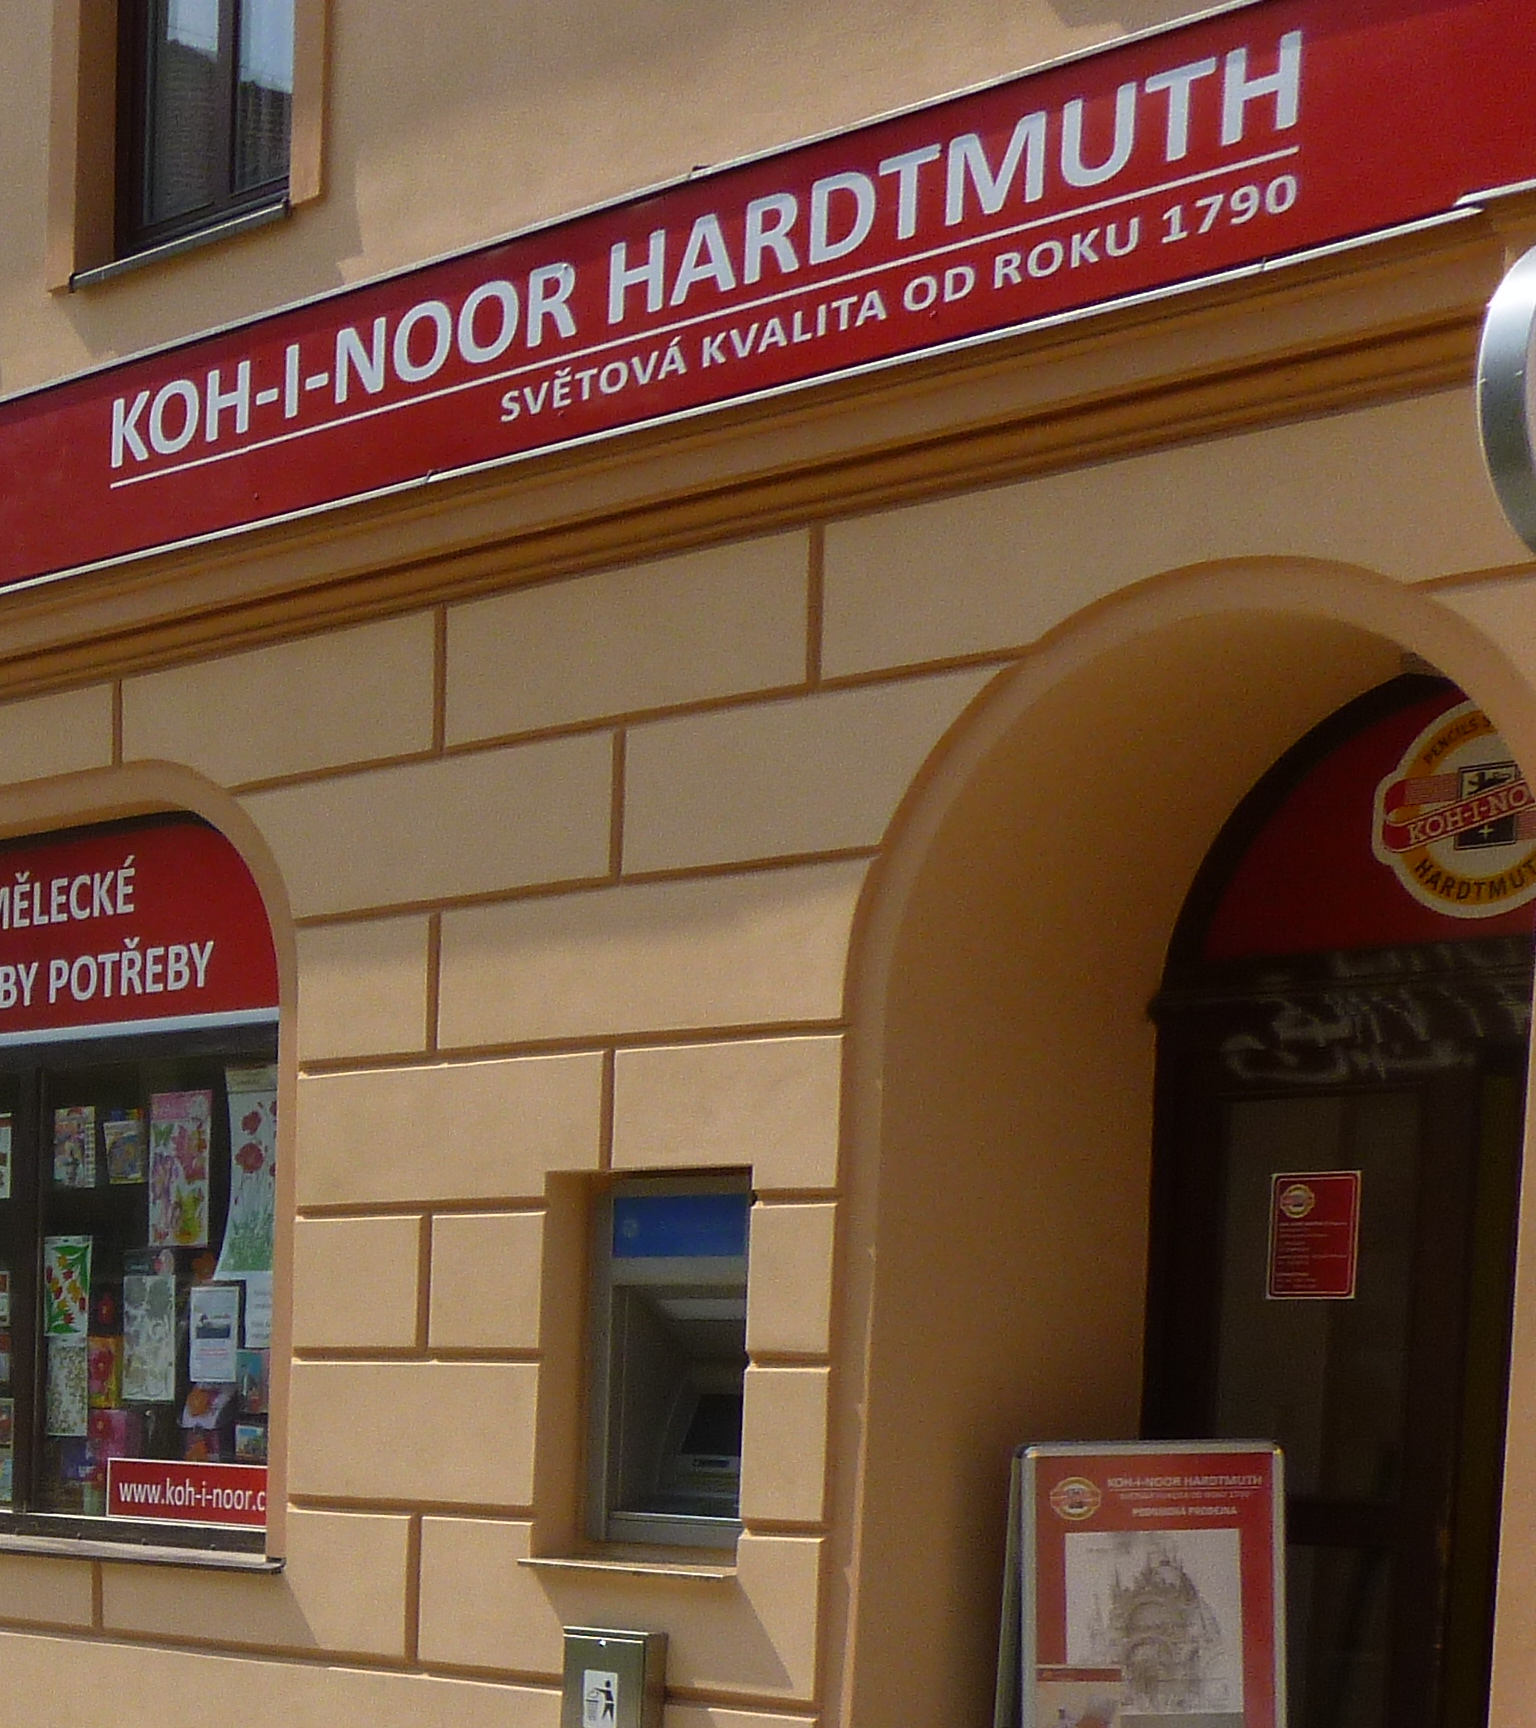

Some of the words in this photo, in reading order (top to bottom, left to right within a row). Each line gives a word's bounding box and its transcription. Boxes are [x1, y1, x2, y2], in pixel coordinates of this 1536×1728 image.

[110, 261, 576, 469] KOH-I-NOOR
[607, 30, 1304, 324] HARDTMUTH
[500, 335, 688, 423] SVĚTOVÁ
[701, 291, 888, 370] KVALITA
[903, 264, 975, 314] OD
[993, 215, 1142, 287] ROKU
[1159, 174, 1300, 245] 1790
[48, 936, 215, 1005] POTŘEBY
